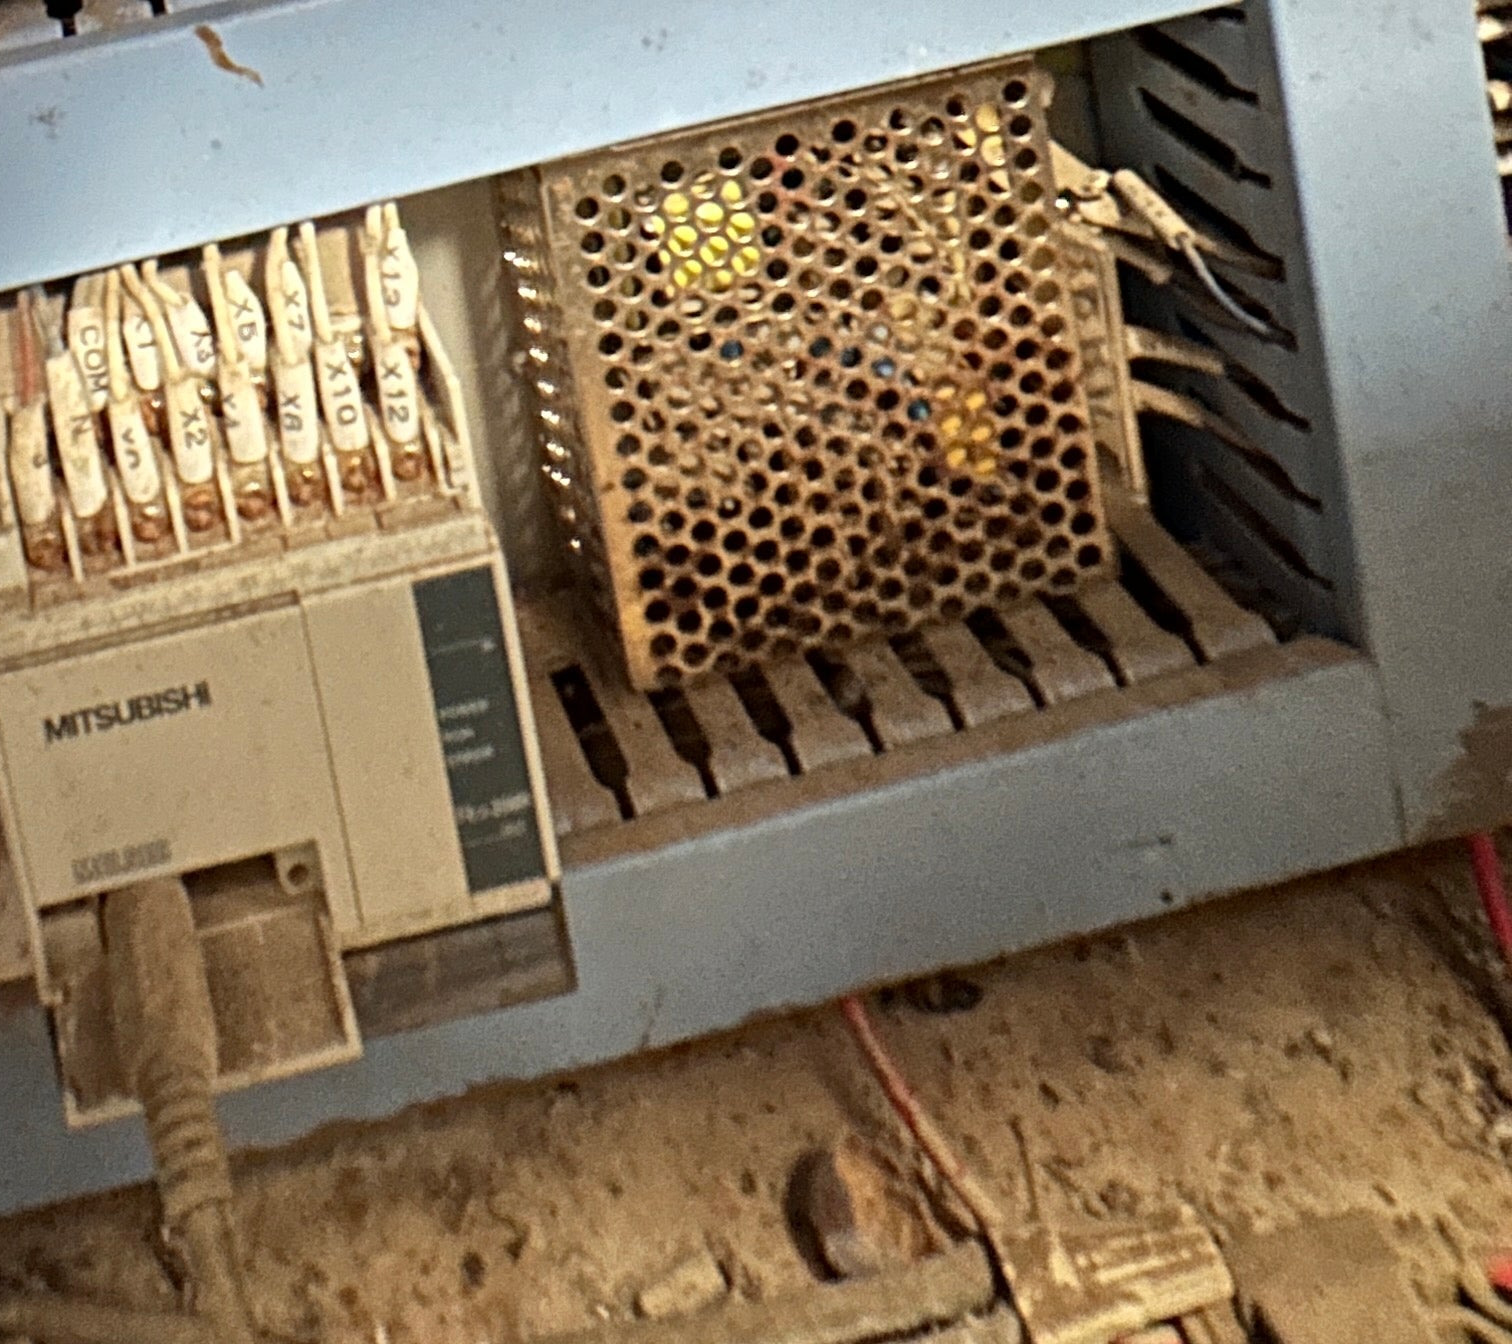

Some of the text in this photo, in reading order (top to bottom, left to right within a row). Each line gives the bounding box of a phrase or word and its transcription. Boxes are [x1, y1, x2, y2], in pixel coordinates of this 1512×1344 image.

[284, 290, 305, 333] X7
[79, 324, 110, 393] COM
[325, 361, 358, 426] X10
[381, 360, 410, 424] X12
[180, 407, 209, 449] X2
[42, 678, 213, 745] MITSUBISHI
